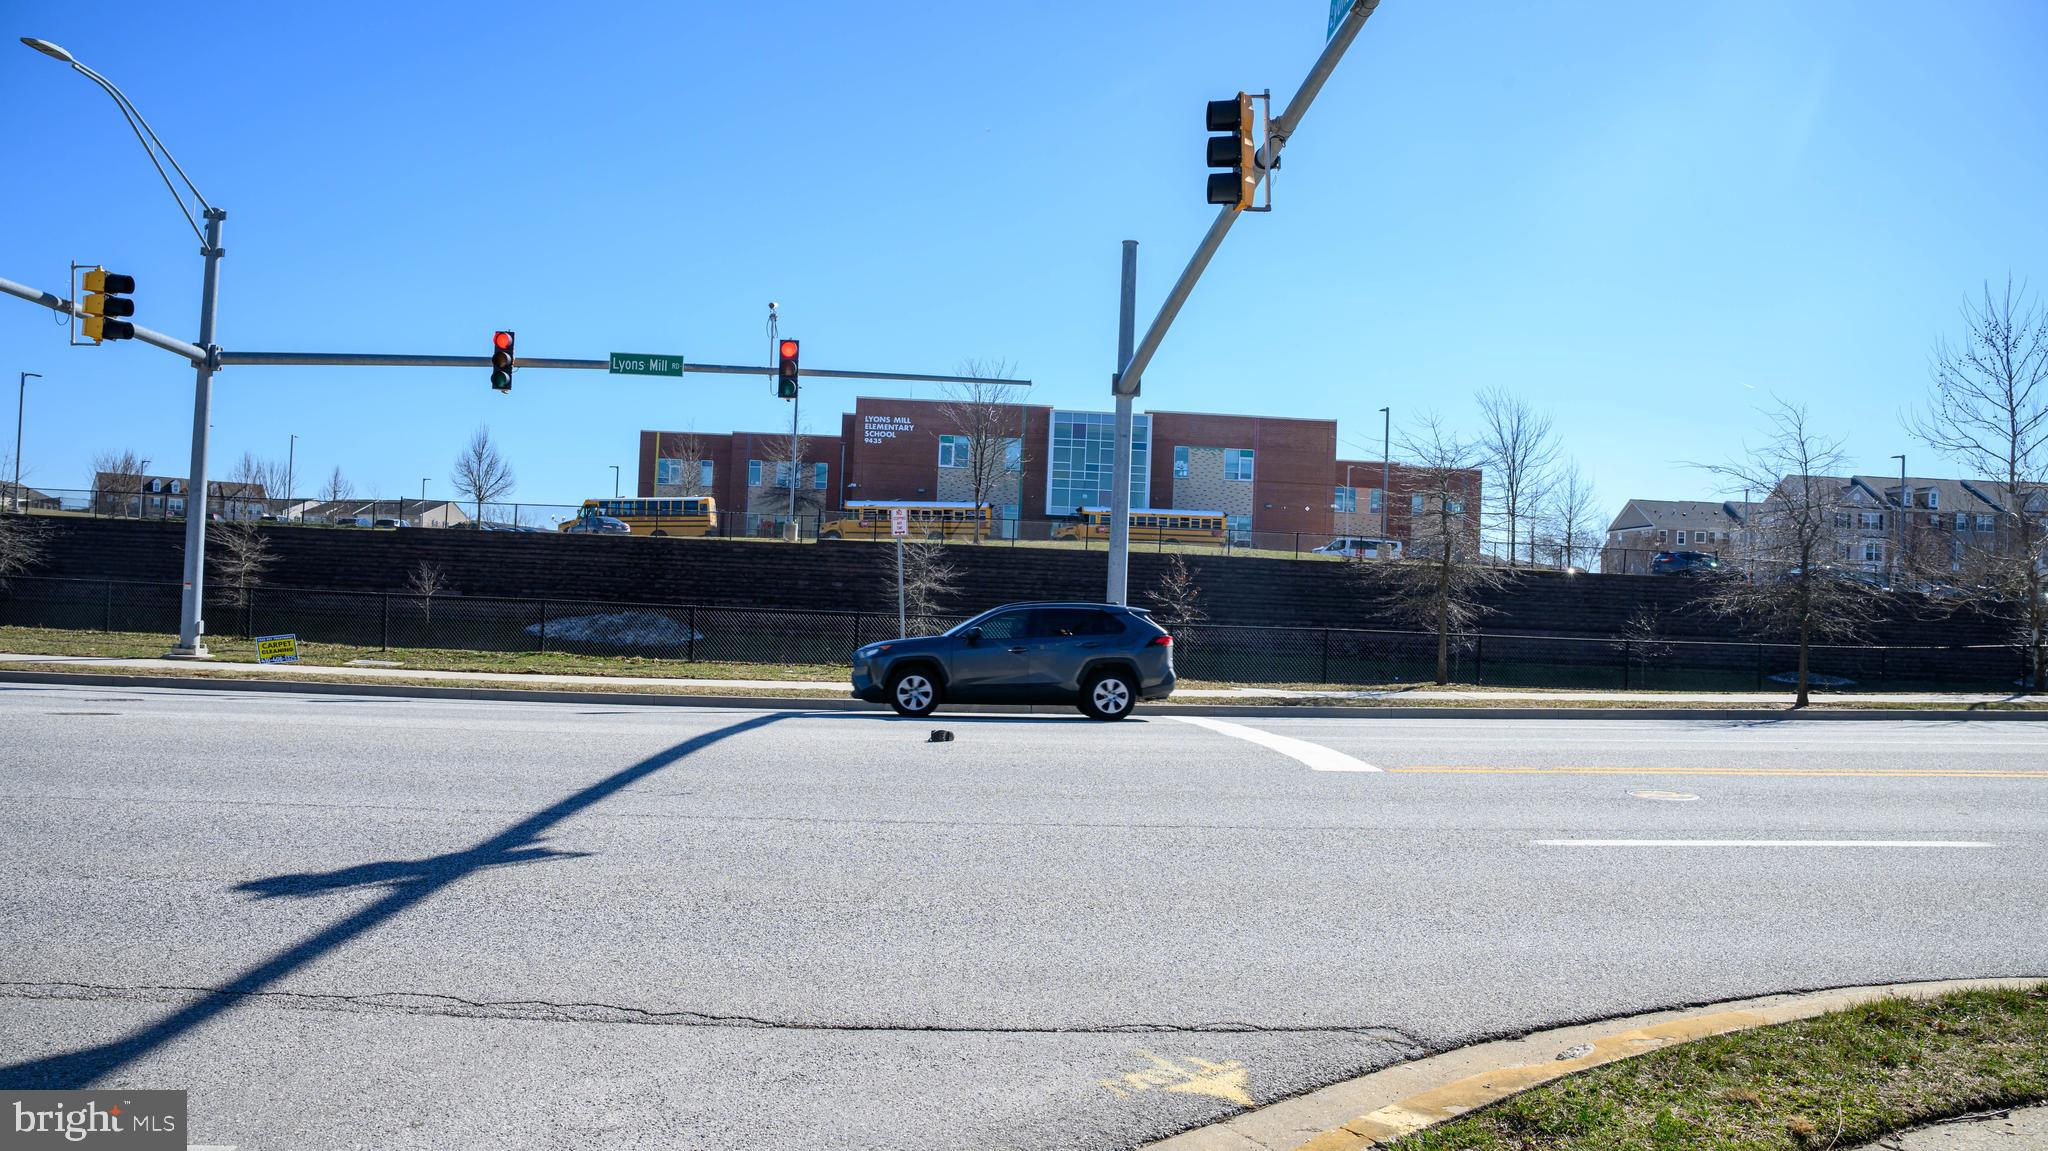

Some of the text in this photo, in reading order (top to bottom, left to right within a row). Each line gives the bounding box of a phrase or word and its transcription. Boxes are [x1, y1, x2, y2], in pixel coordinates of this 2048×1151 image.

[612, 357, 680, 373] Lyons Mill RD
[864, 415, 912, 424] LYONS MILL
[864, 423, 915, 431] ELEMENTARY
[864, 430, 897, 438] SCHOOL
[261, 640, 292, 649] CARPET
[261, 647, 294, 655] CLEANING
